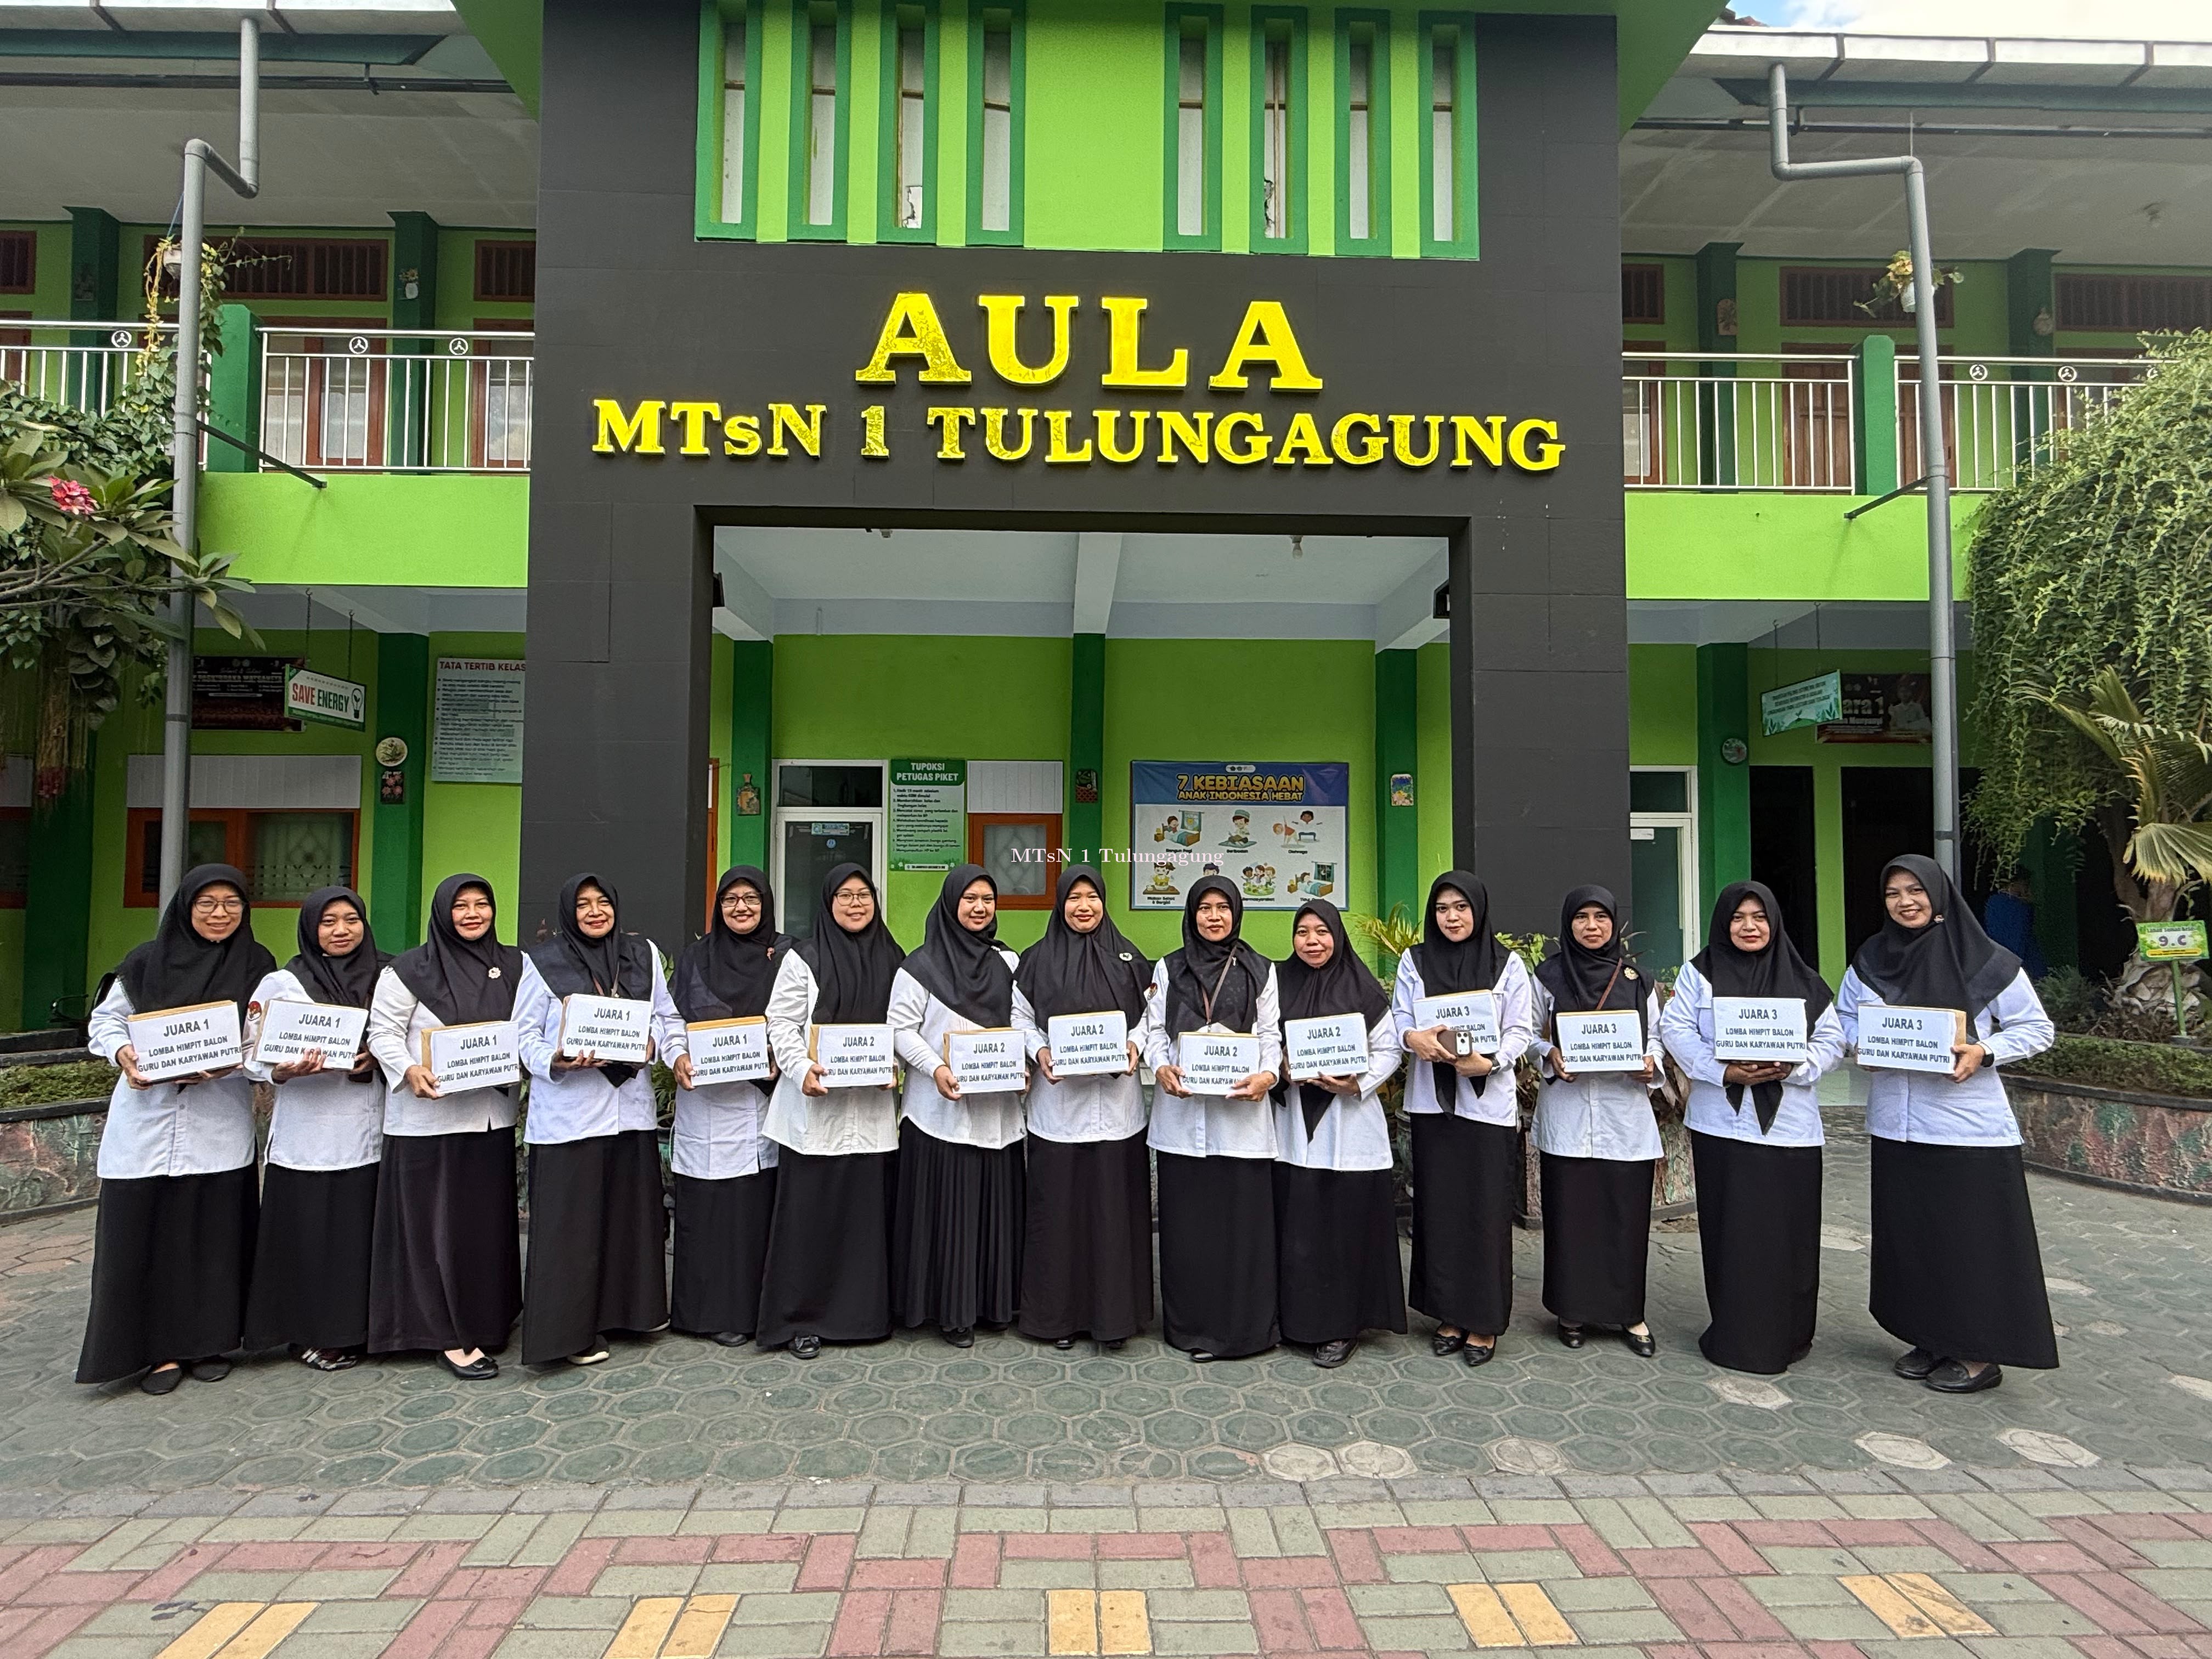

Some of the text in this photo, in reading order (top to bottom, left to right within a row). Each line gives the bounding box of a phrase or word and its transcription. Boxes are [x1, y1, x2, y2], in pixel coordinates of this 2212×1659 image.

[855, 292, 1323, 391] AULA
[592, 399, 1566, 472] MTsN 1 TULUNGAGUNG
[440, 661, 461, 670] TATA
[464, 662, 495, 670] TERTIB
[292, 683, 349, 712] SAVE ENERGY
[1843, 696, 1884, 714] ara 1
[911, 763, 945, 771] TUPOKSI
[935, 773, 958, 781] PIKET
[1177, 775, 1304, 791] 7 KEBIASAAN
[1178, 791, 1304, 801] ANAK INDONESIA HEBAT
[594, 1008, 630, 1021] JUARA 1
[1436, 1006, 1470, 1019] JUARA 3
[1739, 1009, 1778, 1019] JUARA 3
[299, 1014, 340, 1028] JUARA 1
[1466, 1023, 1486, 1031] BALON
[1882, 1018, 1922, 1030] JUARA 3
[163, 1019, 209, 1036] JUARA 1
[578, 1025, 598, 1034] LOMBA
[621, 1029, 640, 1037] BALON
[1071, 1024, 1104, 1036] JUARA 2
[1307, 1026, 1340, 1040] JUARA 2
[1582, 1024, 1617, 1034] JUARA 3
[279, 1032, 302, 1041] LOMBA
[460, 1035, 496, 1049] JUARA 1
[713, 1034, 747, 1047] JUARA 1
[843, 1036, 874, 1047] JUARA 2
[1868, 1036, 1889, 1045] LOMBA
[1916, 1040, 1938, 1048] BALON
[149, 1046, 174, 1057] LOMBA
[204, 1036, 228, 1046] BALON
[974, 1042, 1005, 1054] JUARA 2
[1060, 1045, 1078, 1053] LOMBA
[1204, 1046, 1237, 1057] JUARA 2
[1338, 1044, 1356, 1052] BALON
[162, 1059, 176, 1068] DAN
[448, 1059, 468, 1068] LOMBA
[492, 1052, 510, 1062] BALON
[701, 1056, 720, 1064] LOMBA
[504, 1064, 519, 1073] PUTR
